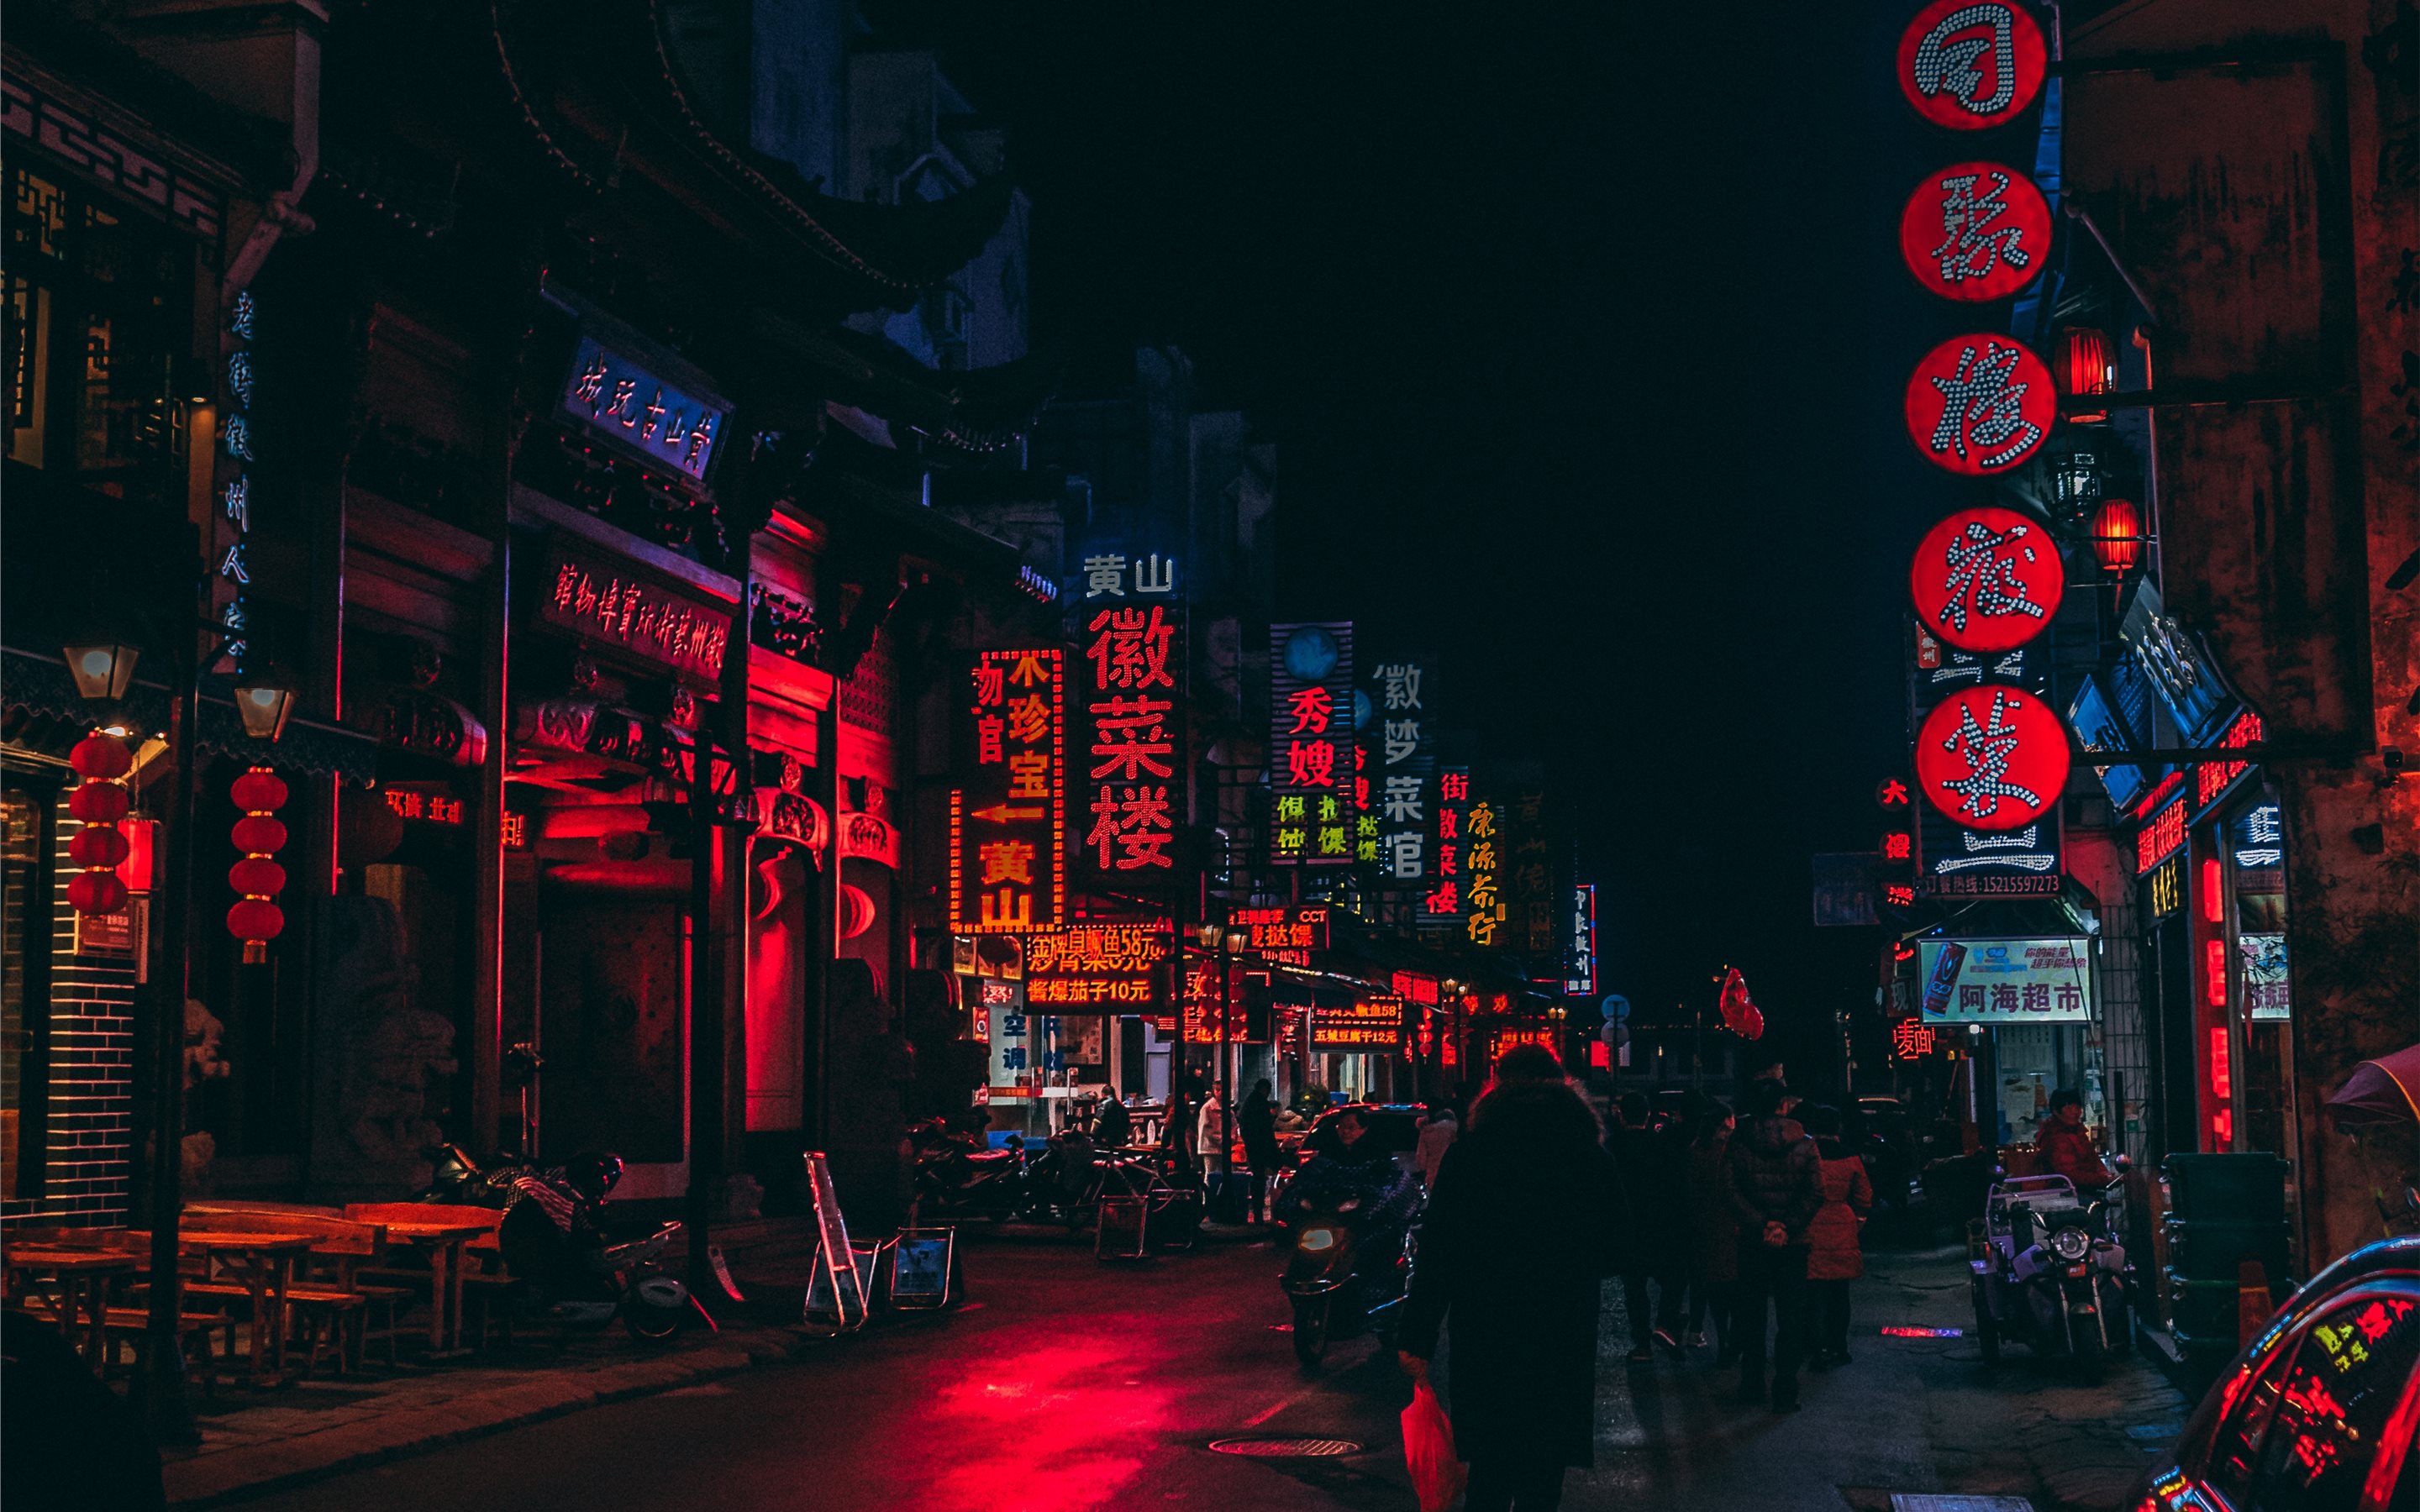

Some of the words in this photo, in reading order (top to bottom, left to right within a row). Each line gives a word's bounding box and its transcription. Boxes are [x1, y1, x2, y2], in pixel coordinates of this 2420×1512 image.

[1083, 552, 1174, 598] 黄山
[1087, 605, 1177, 873] 徽菜楼
[1286, 685, 1336, 789] 秀嫂
[980, 840, 1035, 926] 黄山
[1028, 979, 1151, 1002] 酱爆茄子10元
[1959, 981, 2083, 1014] 阿海超市
[1003, 1016, 1026, 1068] 空调
